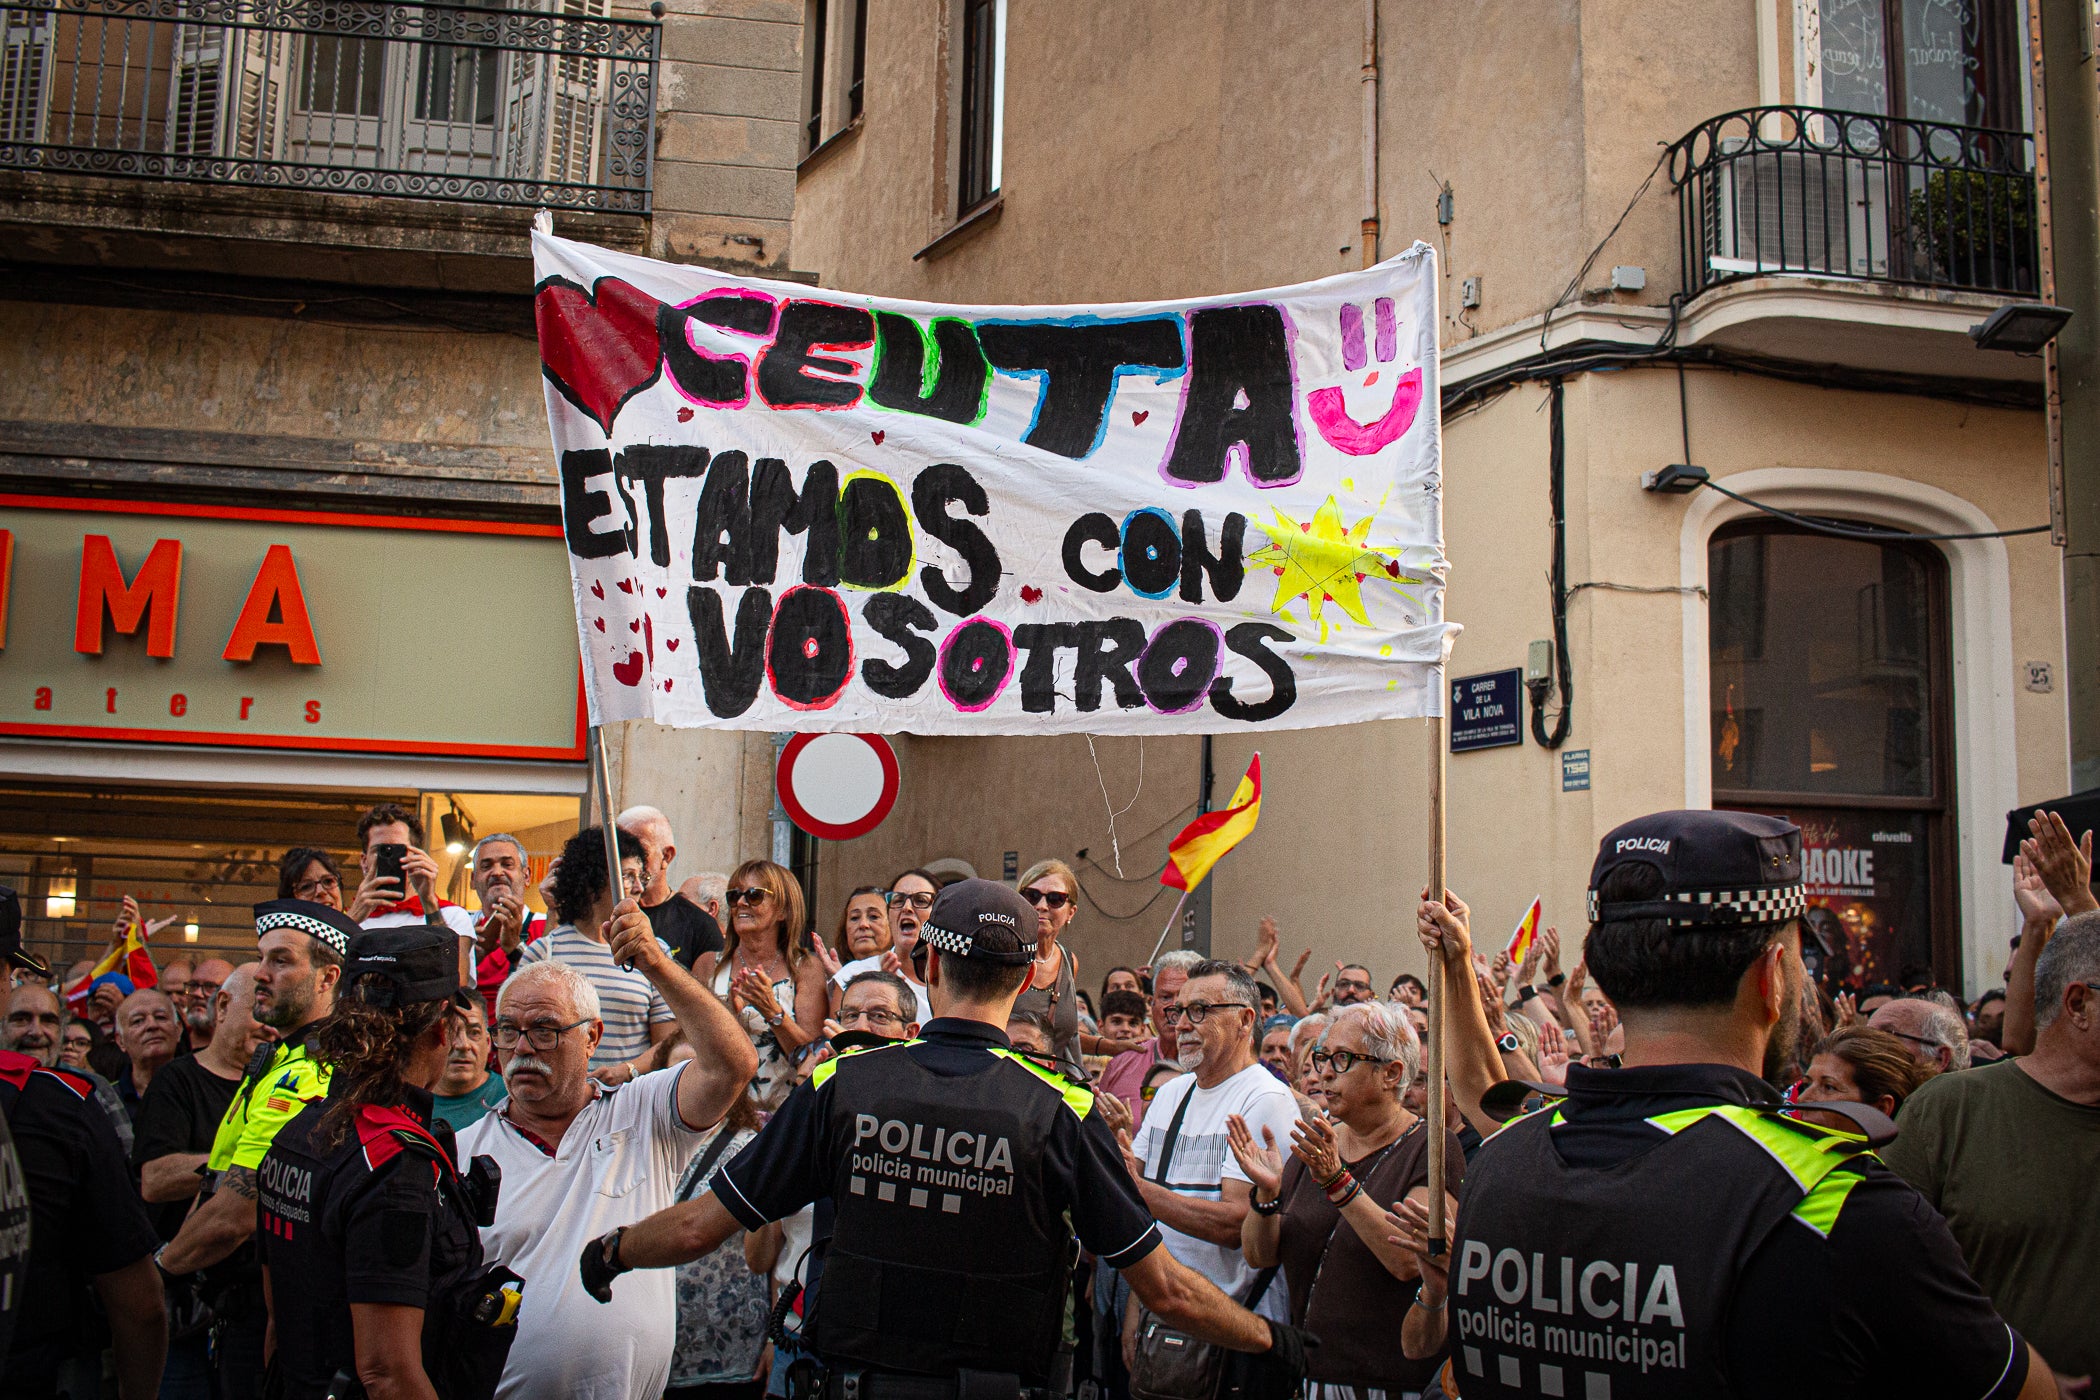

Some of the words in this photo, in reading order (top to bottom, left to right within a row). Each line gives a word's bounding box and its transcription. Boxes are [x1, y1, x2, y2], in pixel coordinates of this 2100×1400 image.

[664, 287, 1307, 490] CEUTA
[561, 443, 1003, 618] ESTAMOS
[1061, 505, 1247, 602] CON
[687, 582, 1298, 719] VOSOTROS
[1471, 680, 1496, 694] CARRER
[1476, 695, 1483, 704] DE
[1484, 694, 1491, 703] LA
[1463, 707, 1481, 721] VILA
[1483, 704, 1504, 718] NOVA
[1616, 837, 1671, 855] POLICIA
[978, 913, 1015, 927] POLICIA
[853, 1113, 1014, 1173] POLICIA
[260, 1155, 312, 1203] POLICIA
[852, 1152, 911, 1180] policia
[917, 1165, 1014, 1197] municipal
[1457, 1239, 1686, 1328] POLICIA
[1457, 1305, 1537, 1349] policia
[1544, 1325, 1686, 1374] municipal
